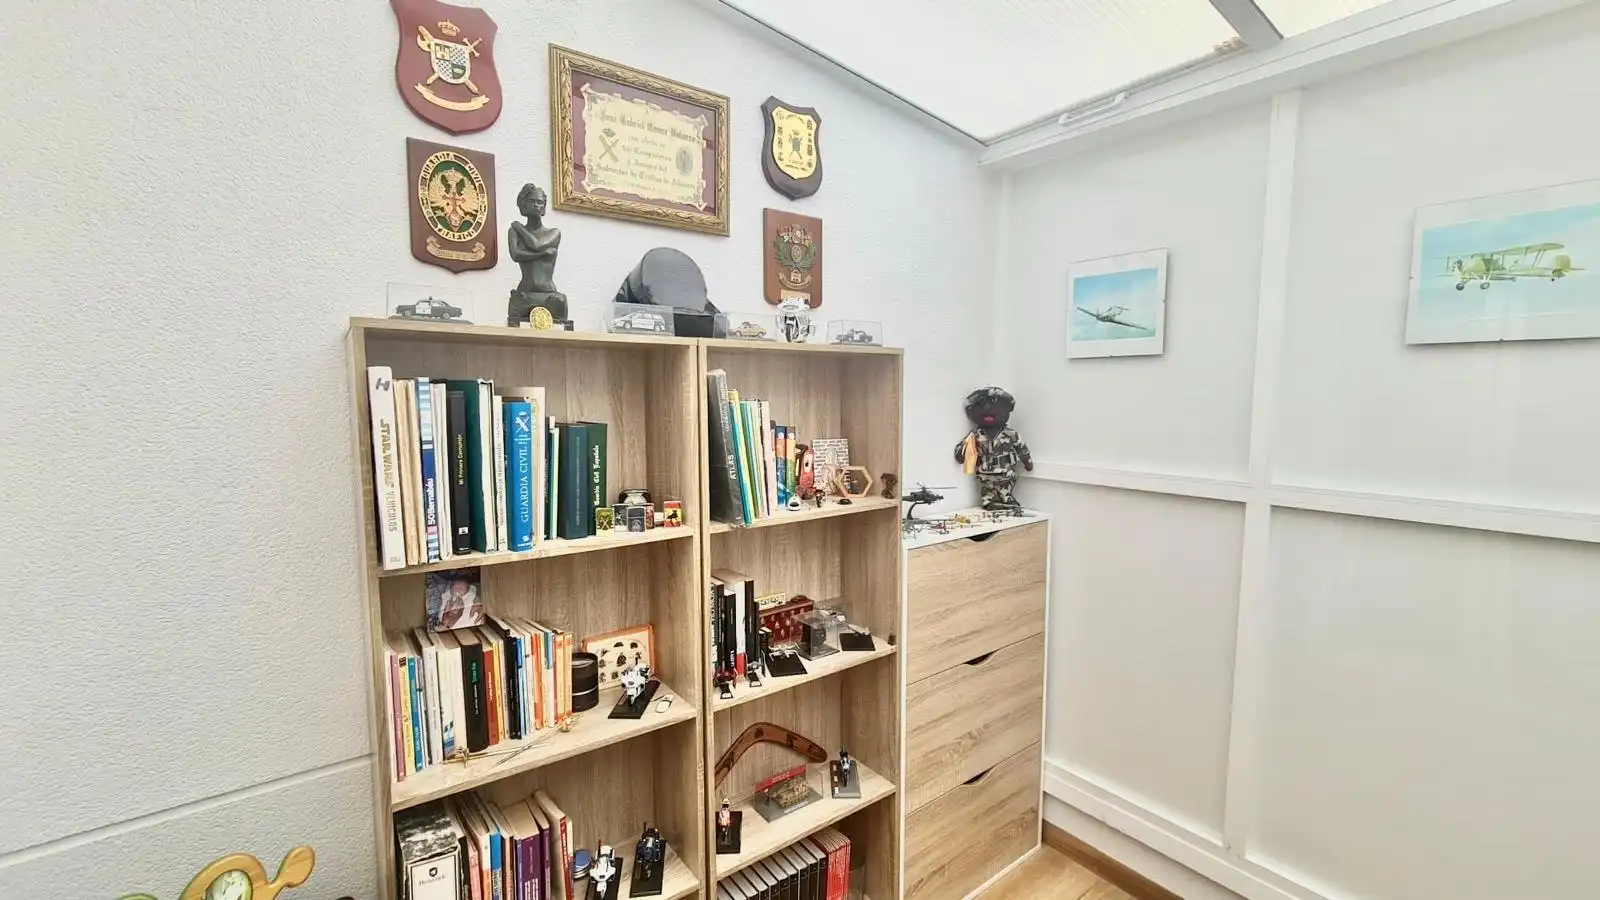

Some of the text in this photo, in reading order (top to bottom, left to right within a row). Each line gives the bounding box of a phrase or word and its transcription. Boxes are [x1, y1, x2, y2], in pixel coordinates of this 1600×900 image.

[421, 153, 483, 185] GUARDIA CIVIL
[379, 419, 392, 454] STAR
[383, 454, 395, 487] WARS
[727, 454, 738, 479] ATLAS
[519, 446, 531, 522] GUARDIA CIVIL
